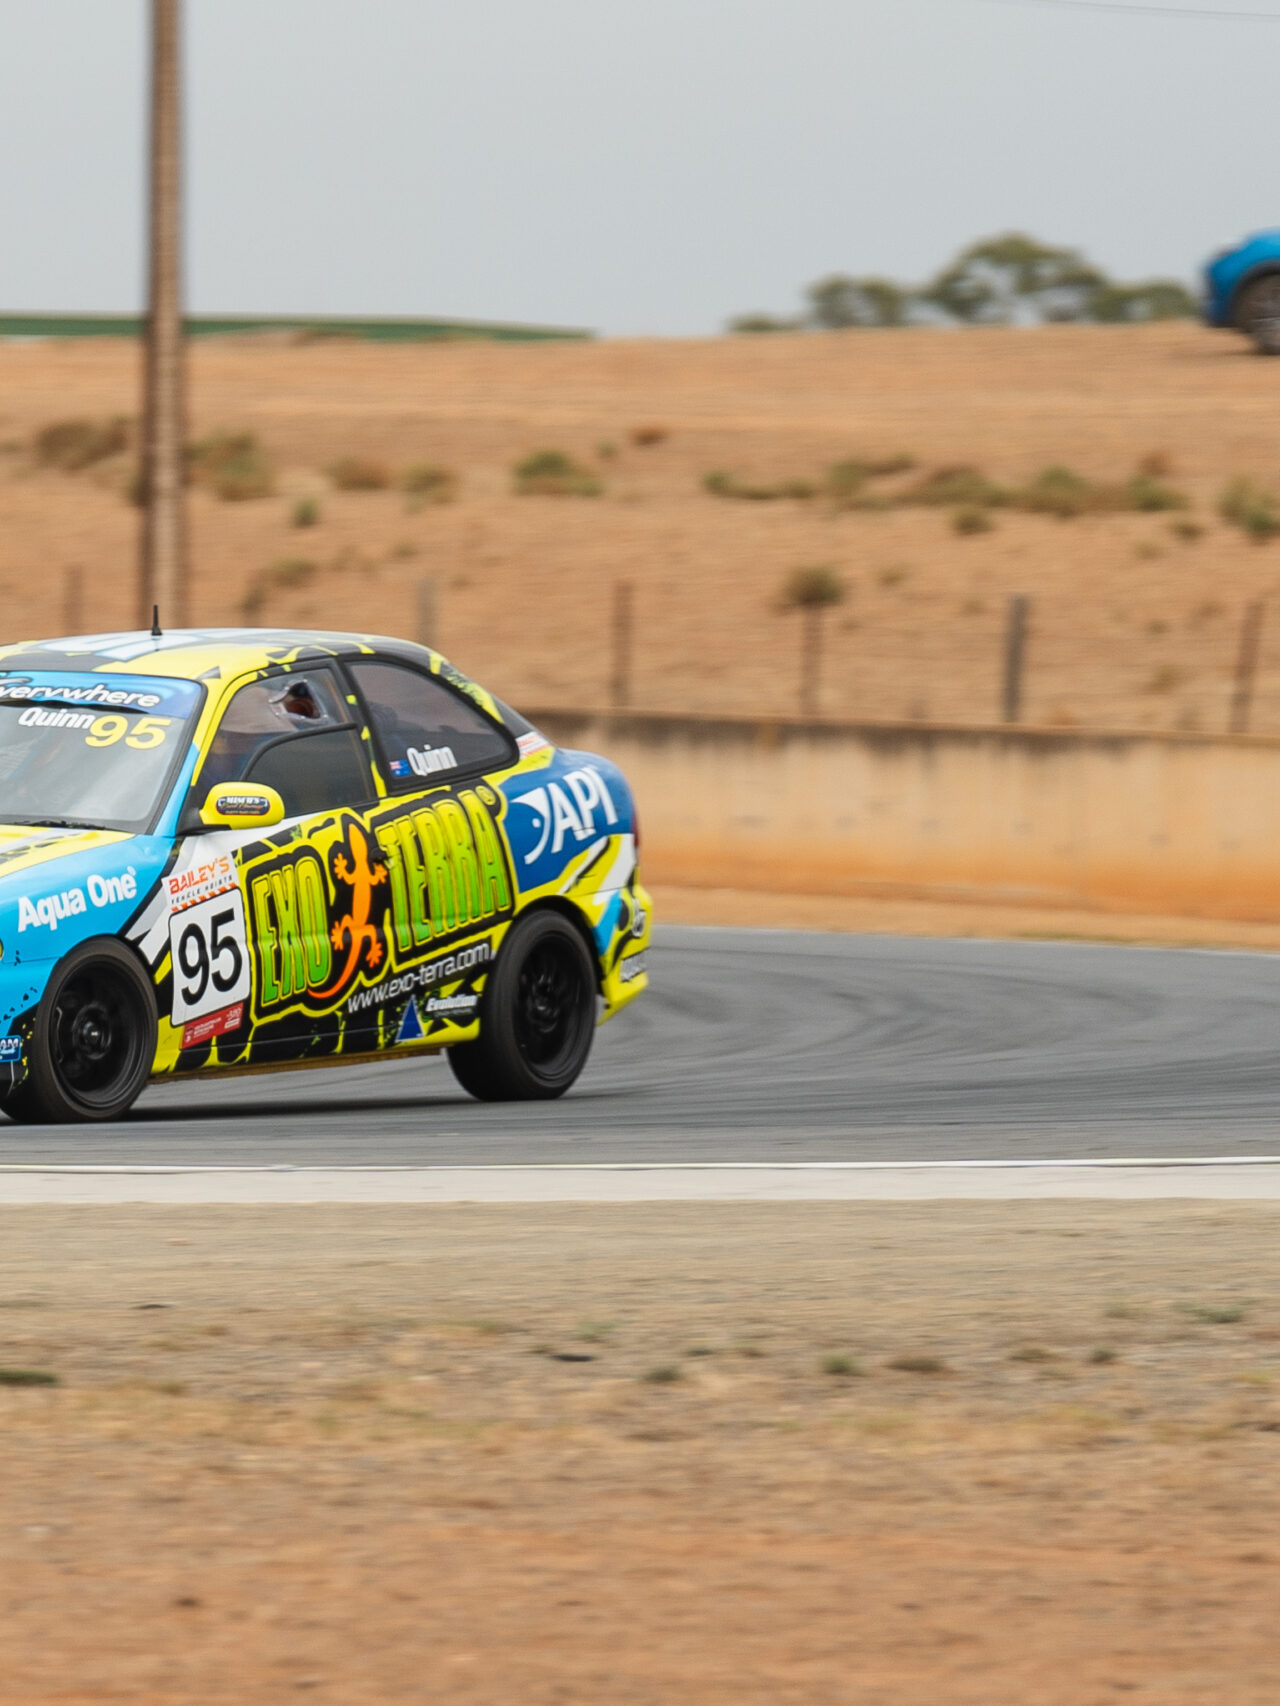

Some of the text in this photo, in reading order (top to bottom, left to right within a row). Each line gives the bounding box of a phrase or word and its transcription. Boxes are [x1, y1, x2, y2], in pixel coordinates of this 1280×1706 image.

[18, 707, 96, 729] Quinn
[85, 714, 172, 750] 95
[407, 744, 458, 776] Quinn
[551, 767, 618, 853] API
[17, 873, 137, 932] Aqua One
[169, 856, 230, 895] BAILEY'S
[375, 789, 510, 952] TERRA
[178, 908, 243, 1005] 95
[251, 856, 331, 1007] EXO
[348, 943, 489, 1013] www.exo-terra.com
